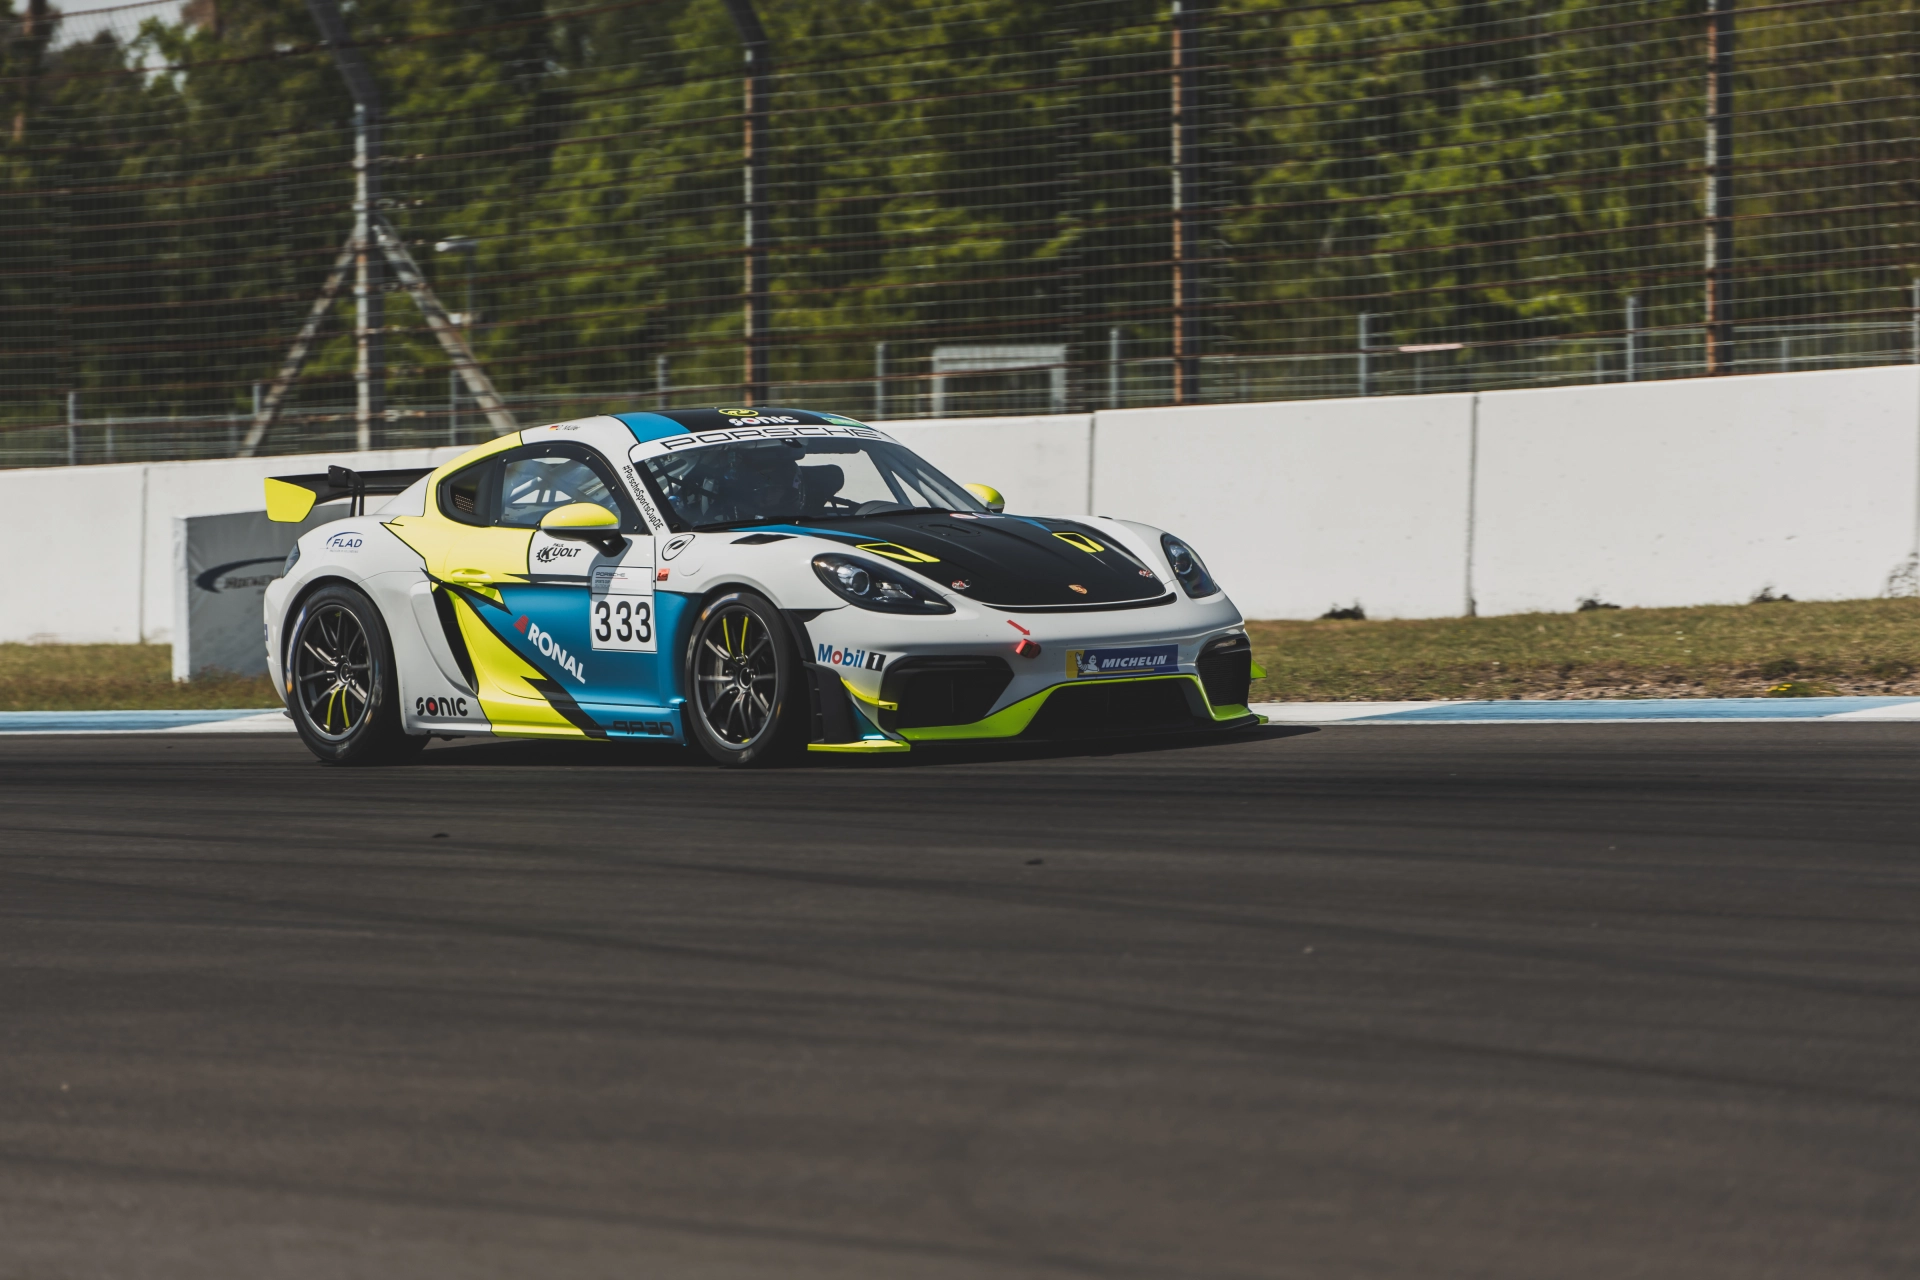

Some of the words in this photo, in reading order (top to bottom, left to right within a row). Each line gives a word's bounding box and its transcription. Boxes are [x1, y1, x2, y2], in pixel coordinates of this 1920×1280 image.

[660, 427, 882, 450] PORSCHE
[622, 465, 664, 531] #PorscheSportsCupDE
[332, 539, 363, 548] FLAD
[541, 546, 582, 559] KUOLT
[595, 601, 651, 643] 333
[527, 622, 586, 684] RONAL
[817, 643, 866, 668] Mobil
[1101, 655, 1168, 668] MICHELIN
